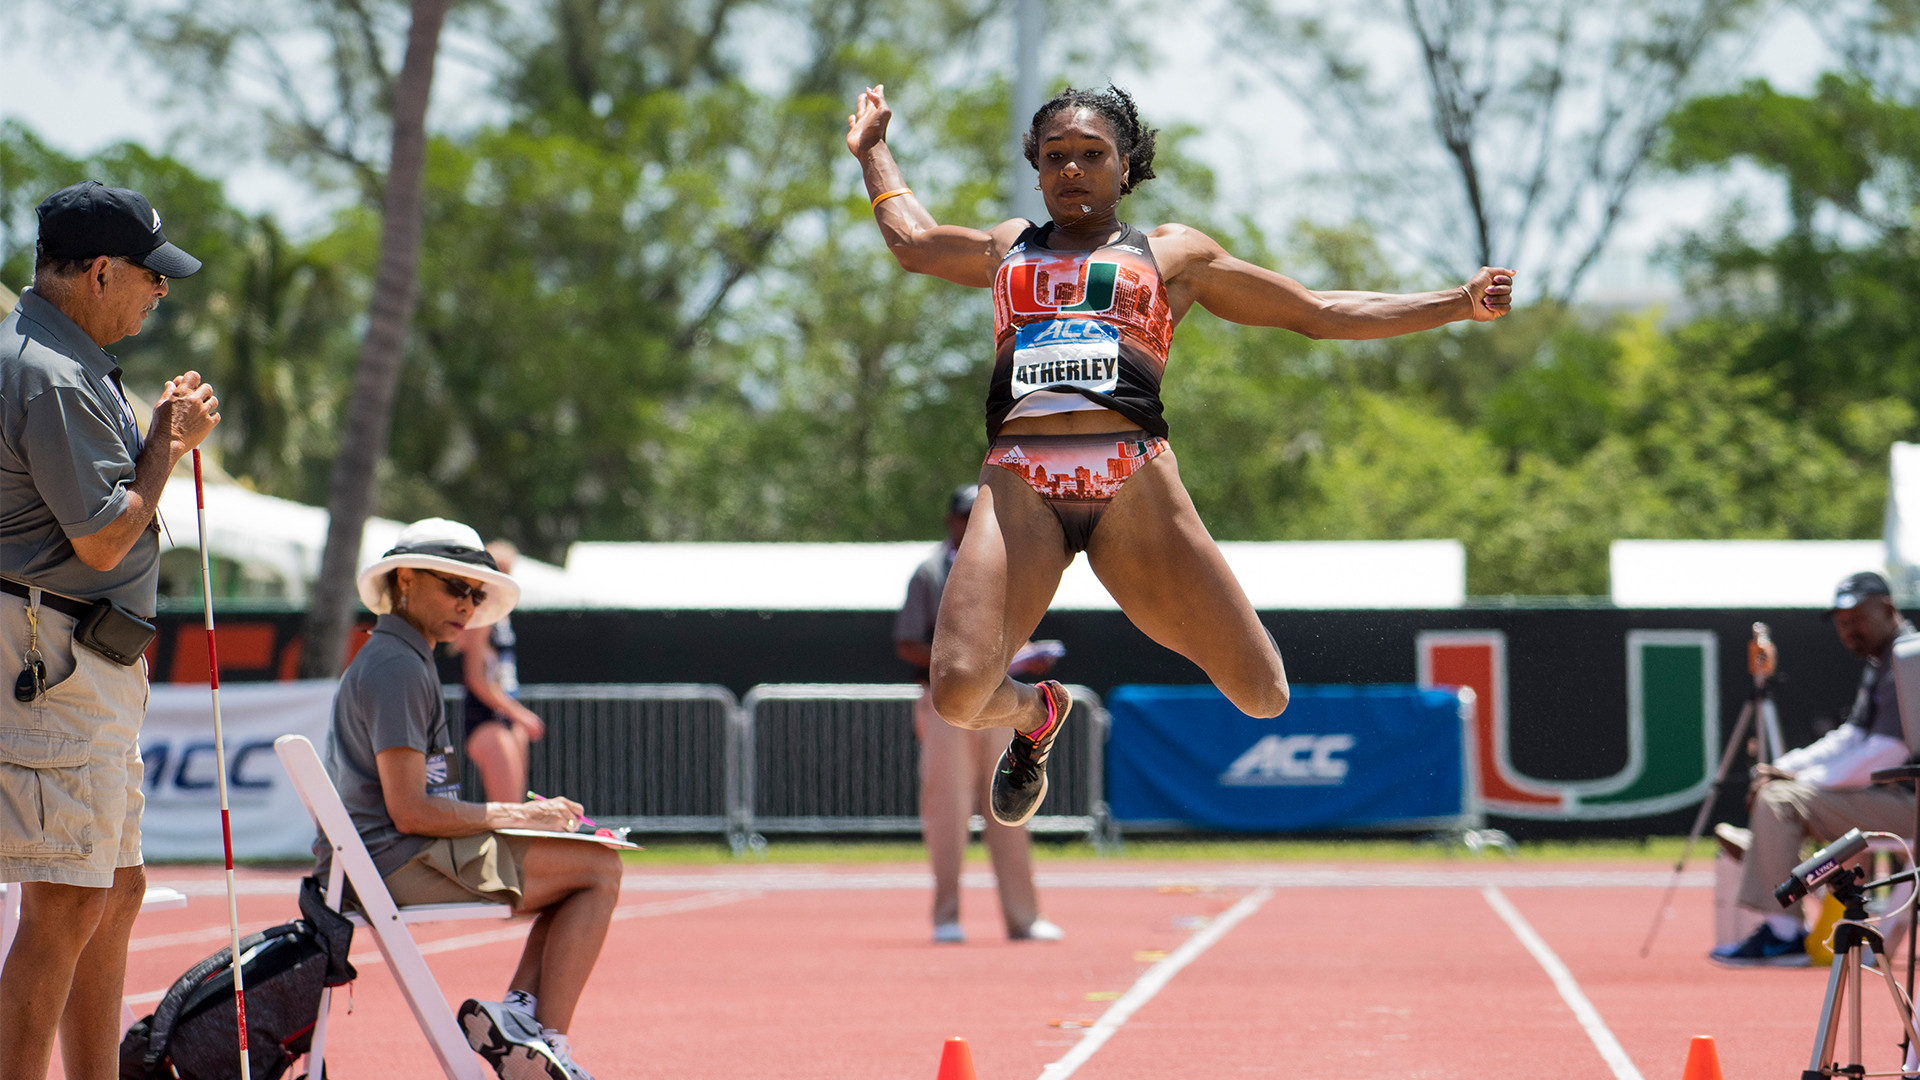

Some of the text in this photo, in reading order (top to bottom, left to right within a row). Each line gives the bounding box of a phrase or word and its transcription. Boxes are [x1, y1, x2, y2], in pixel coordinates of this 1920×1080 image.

[1111, 244, 1145, 256] ACC
[1007, 261, 1121, 315] U
[1033, 320, 1103, 342] ACC
[1016, 358, 1117, 384] ATHERLEY
[998, 457, 1030, 465] adidas
[1220, 734, 1356, 779] ACC
[1814, 861, 1835, 876] LYNX
